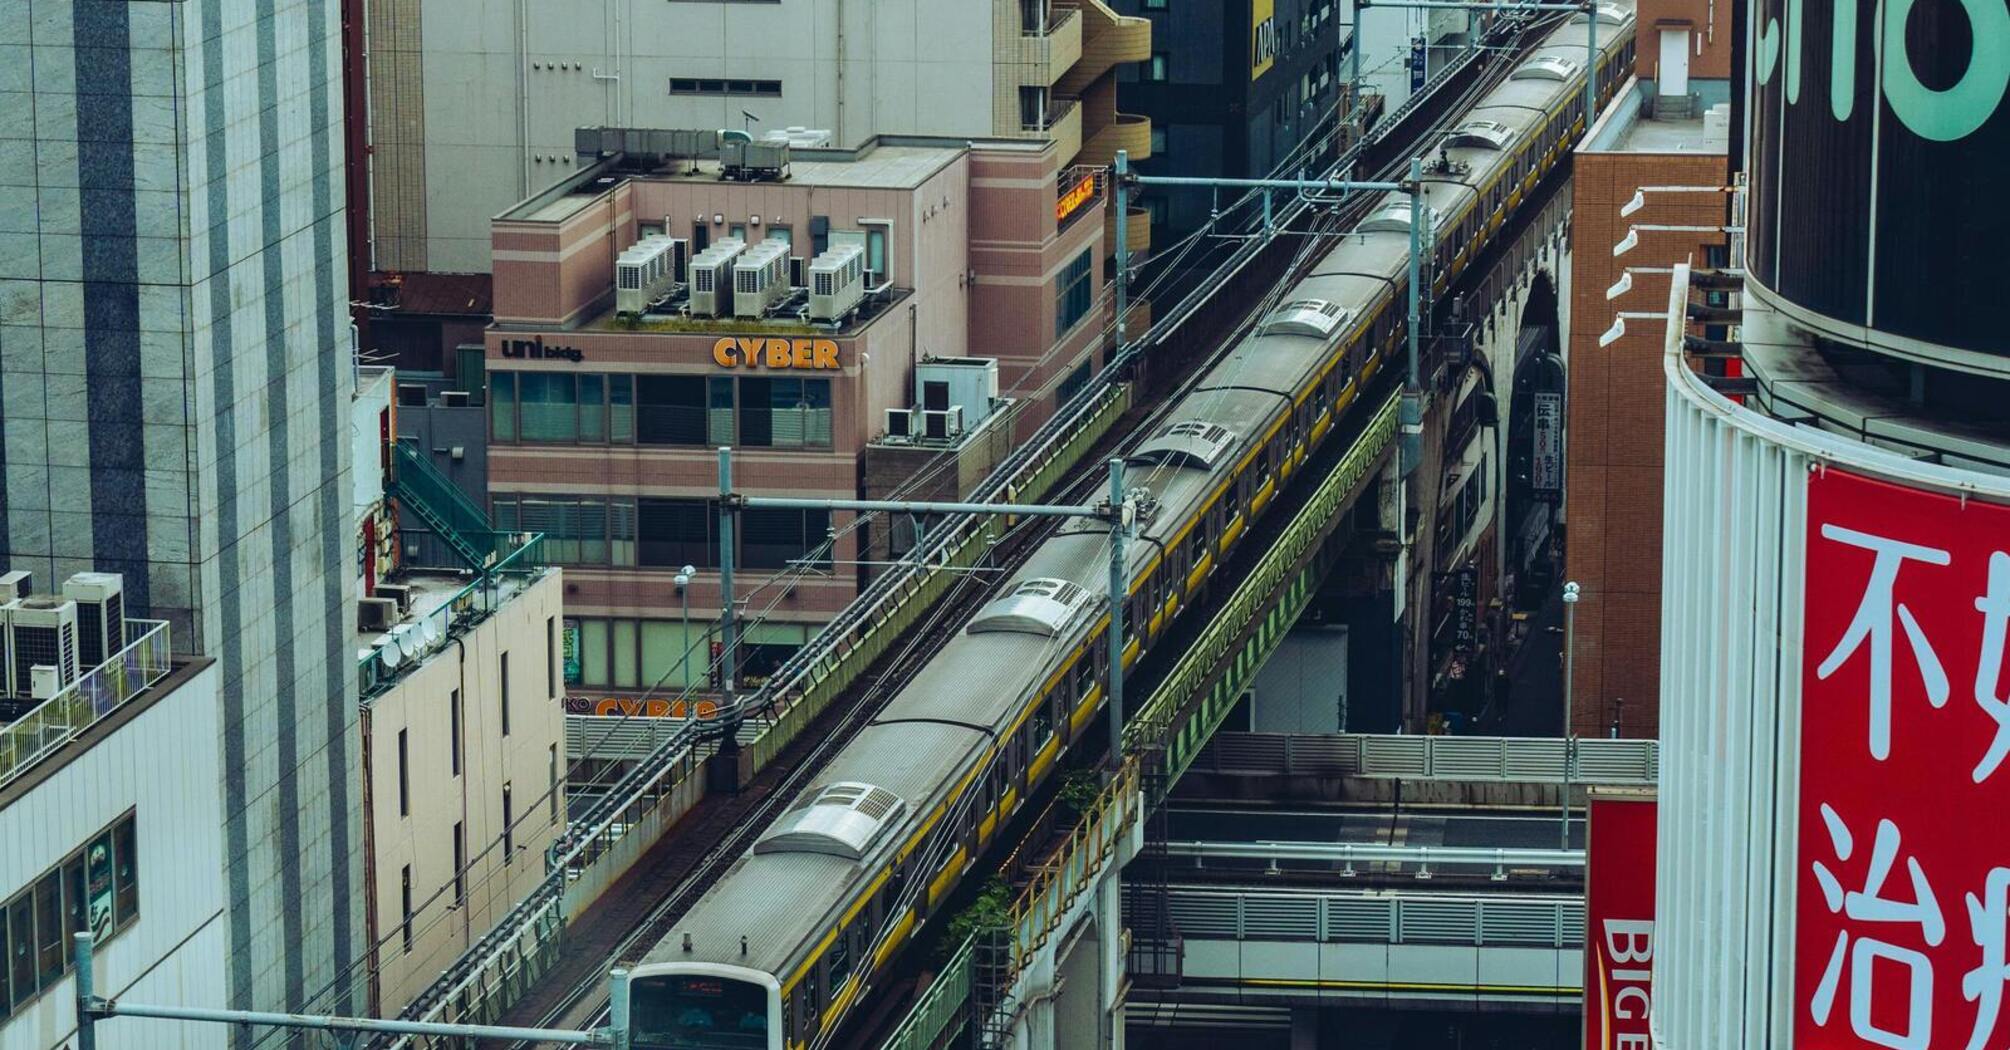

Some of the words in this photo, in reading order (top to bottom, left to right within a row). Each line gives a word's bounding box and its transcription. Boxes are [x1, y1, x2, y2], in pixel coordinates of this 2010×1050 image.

[502, 335, 542, 359] uni
[713, 337, 840, 369] CYBER
[561, 697, 591, 713] KO
